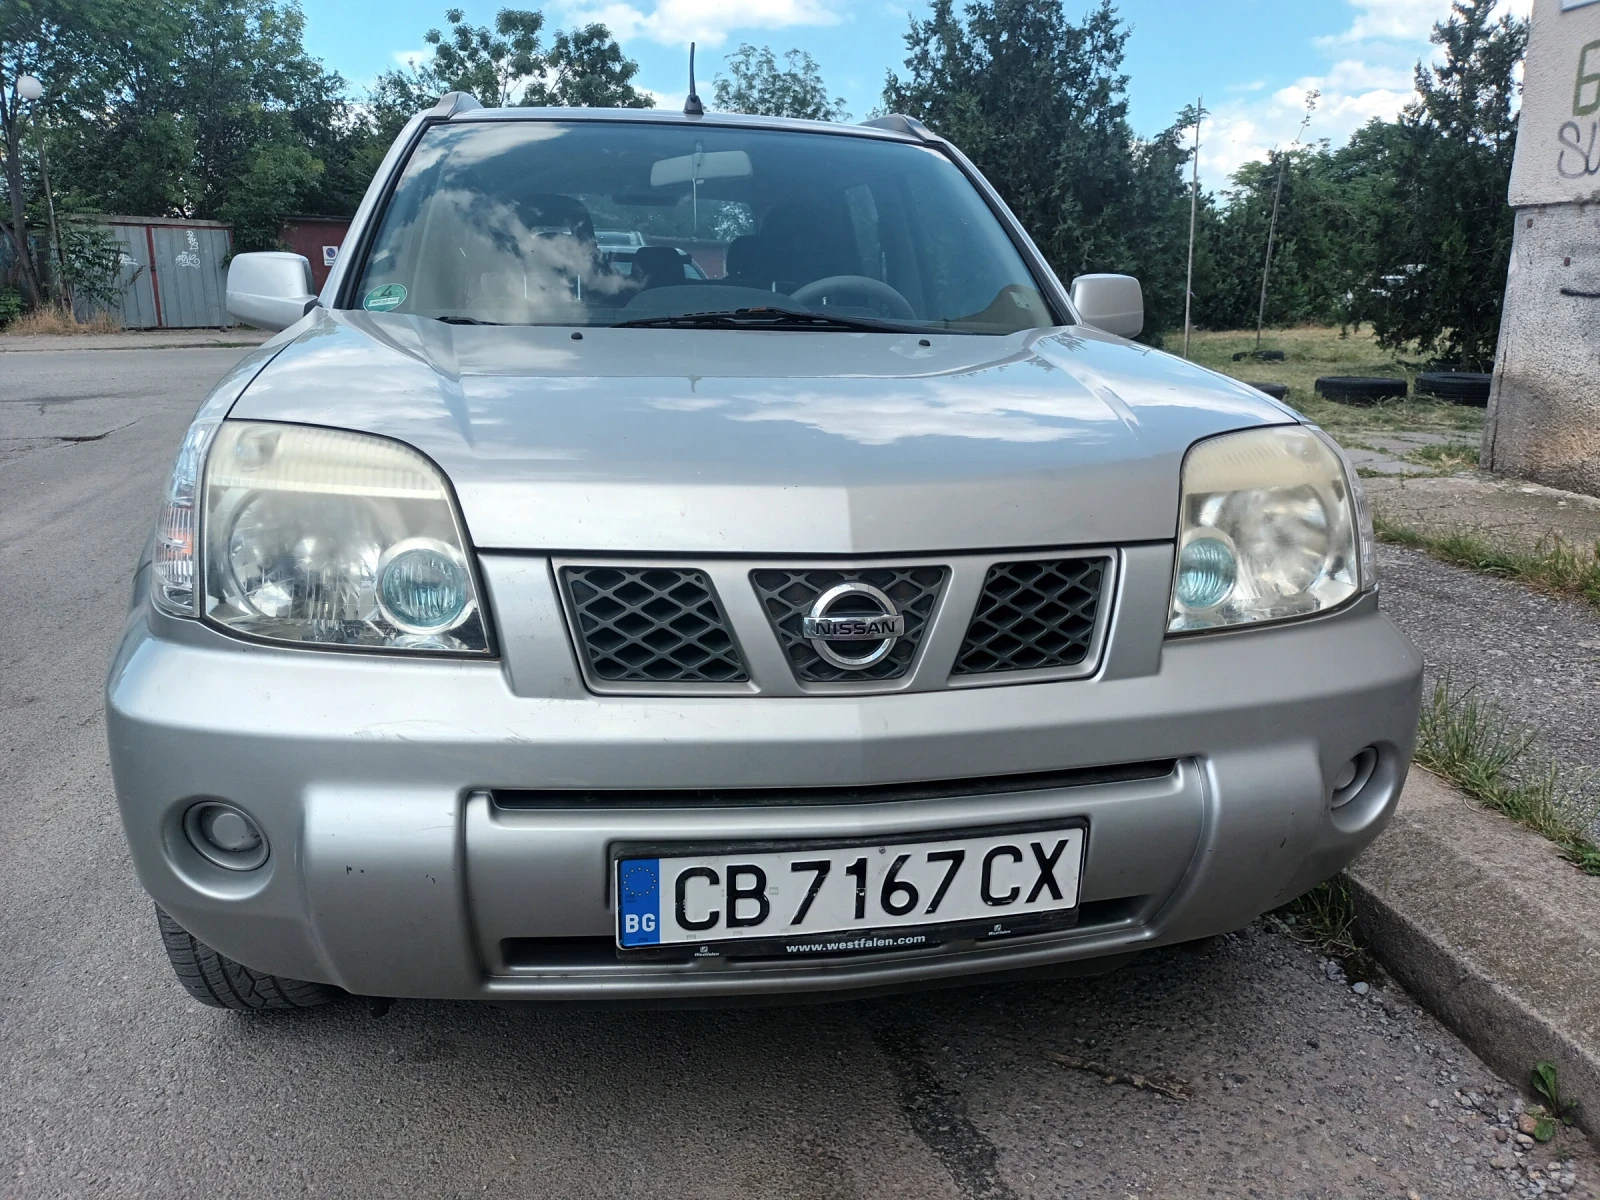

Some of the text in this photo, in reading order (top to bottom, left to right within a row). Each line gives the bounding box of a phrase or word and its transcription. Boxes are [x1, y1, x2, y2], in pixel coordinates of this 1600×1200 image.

[380, 285, 393, 299] 4
[815, 621, 895, 635] NISSAN
[675, 839, 1069, 931] CB 7167 CX
[625, 913, 656, 934] BG
[785, 935, 926, 953] www.westfalen.com
